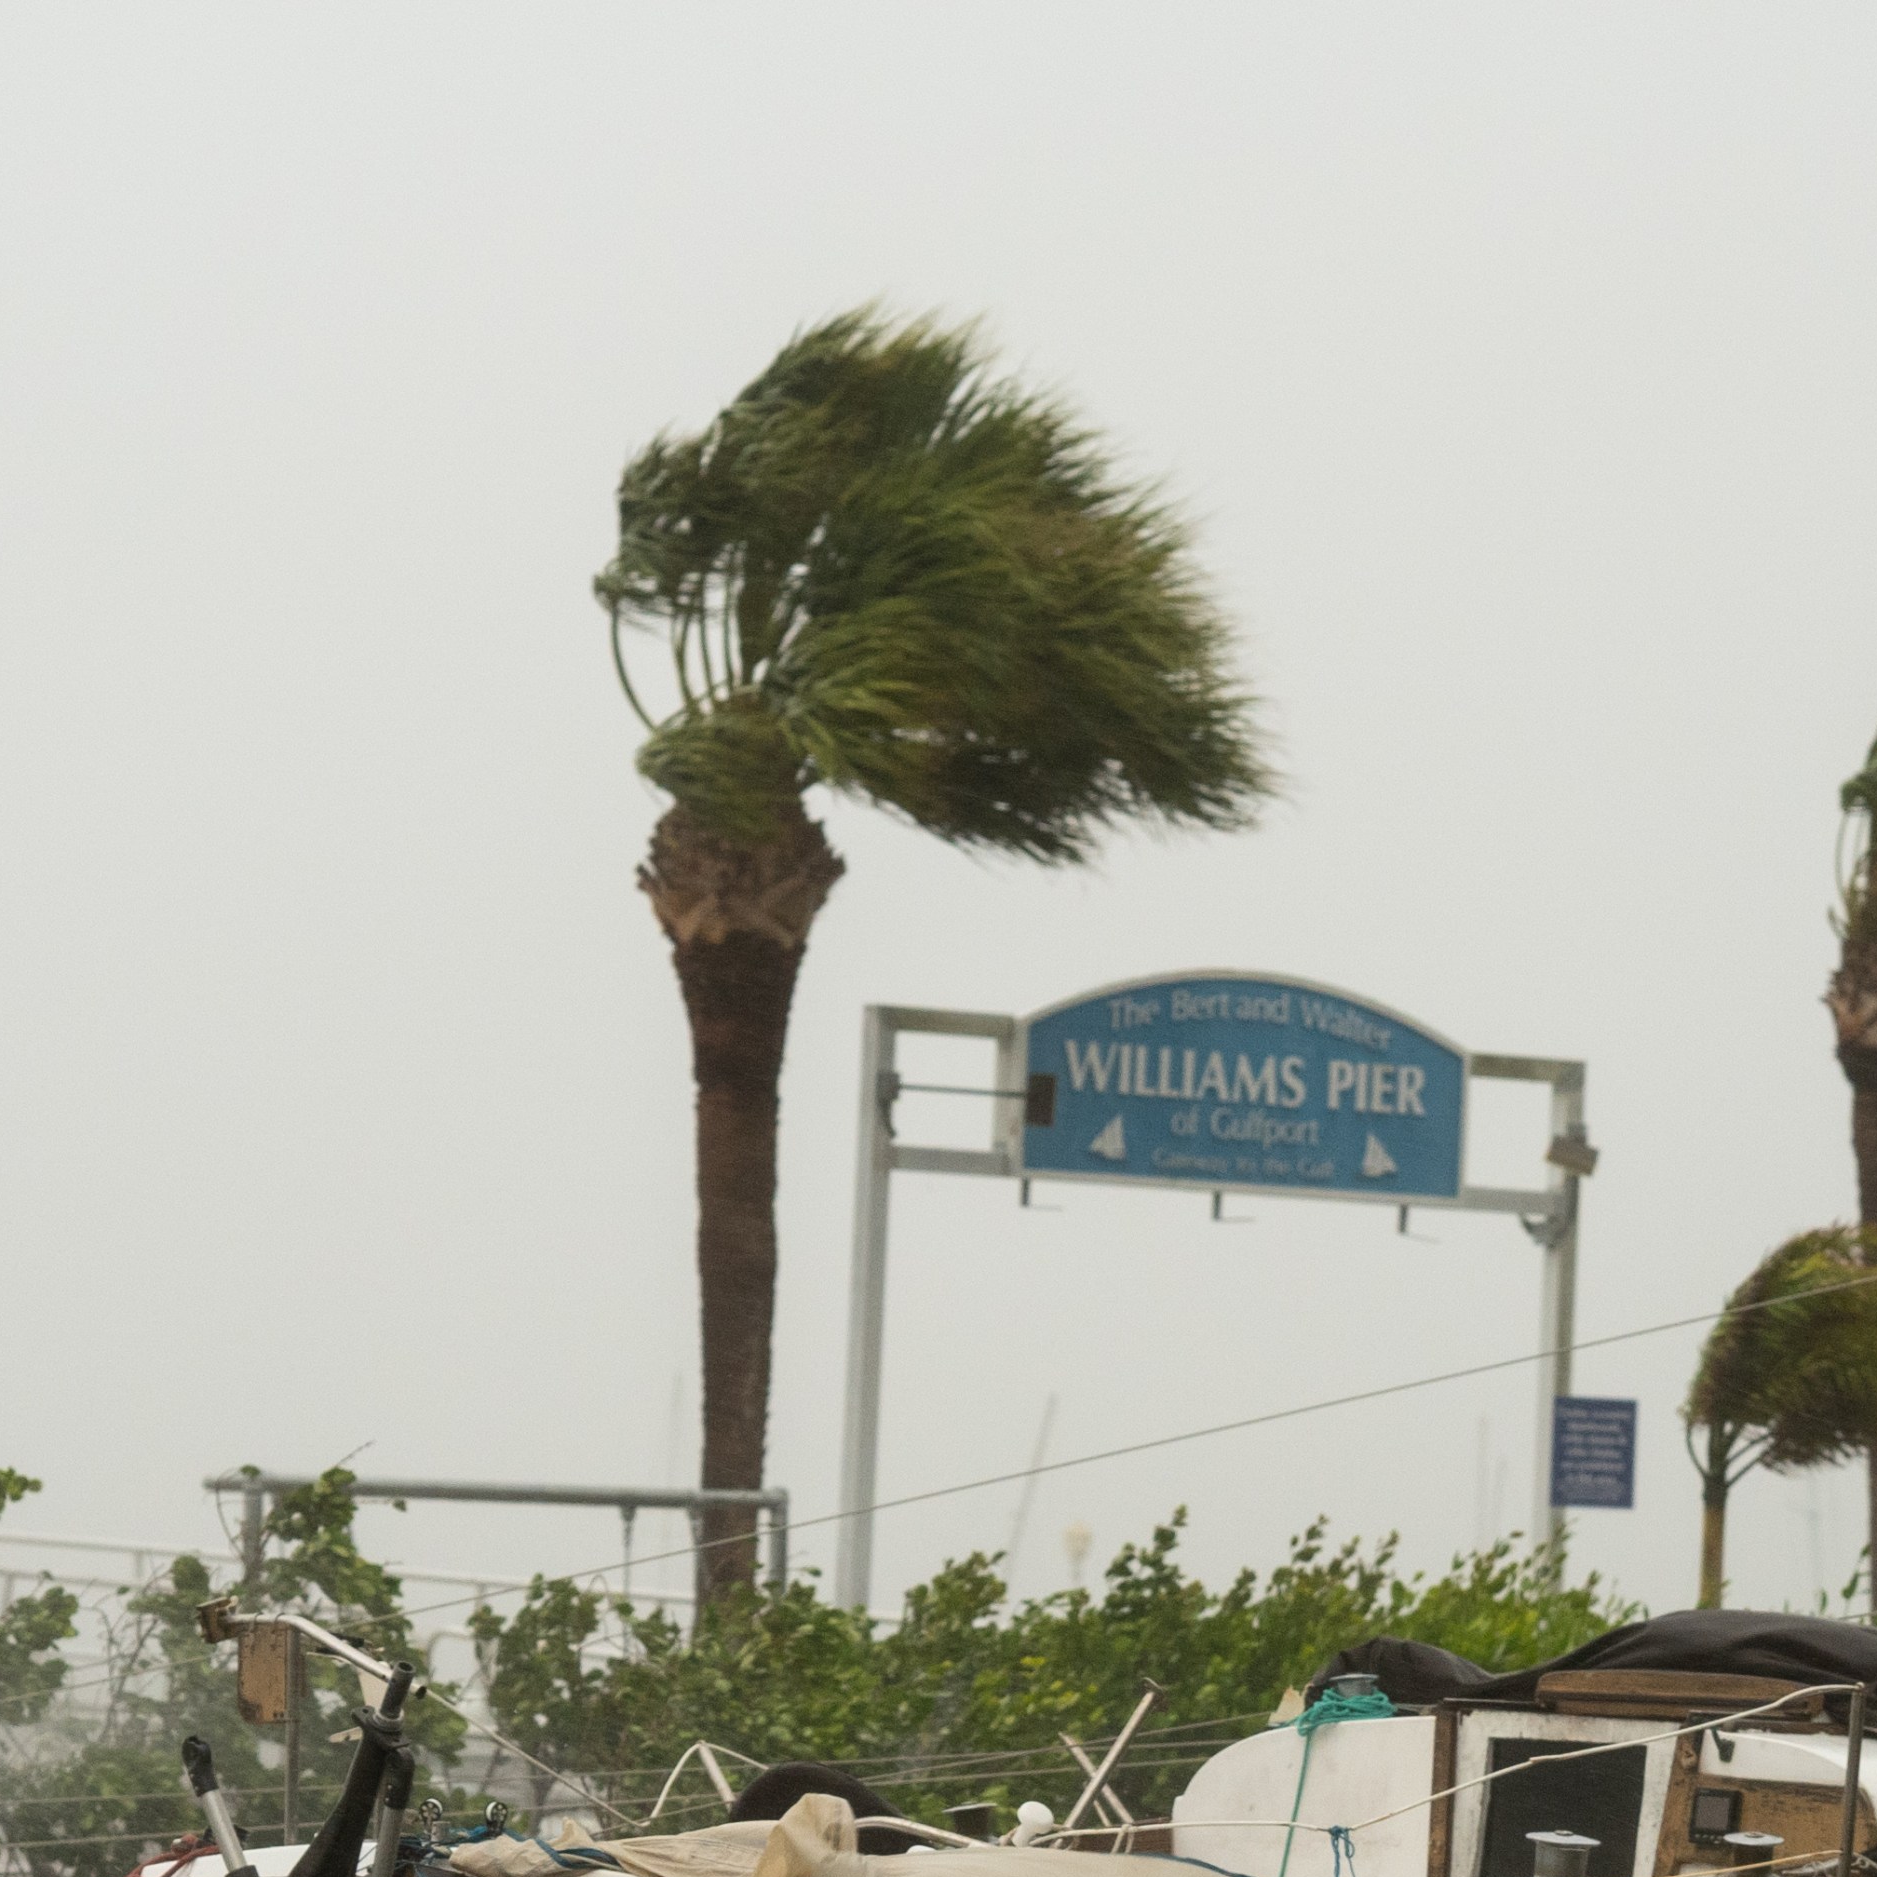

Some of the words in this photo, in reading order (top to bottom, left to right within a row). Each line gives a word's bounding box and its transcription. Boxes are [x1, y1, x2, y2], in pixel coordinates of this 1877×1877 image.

[1107, 996, 1160, 1028] The
[1171, 988, 1230, 1021] Bert
[1235, 993, 1290, 1023] and
[1300, 998, 1392, 1050] Walter
[1064, 1038, 1308, 1108] WILLIAMS
[1327, 1058, 1426, 1117] PIER
[1170, 1107, 1200, 1135] of
[1210, 1107, 1320, 1150] Gulfport
